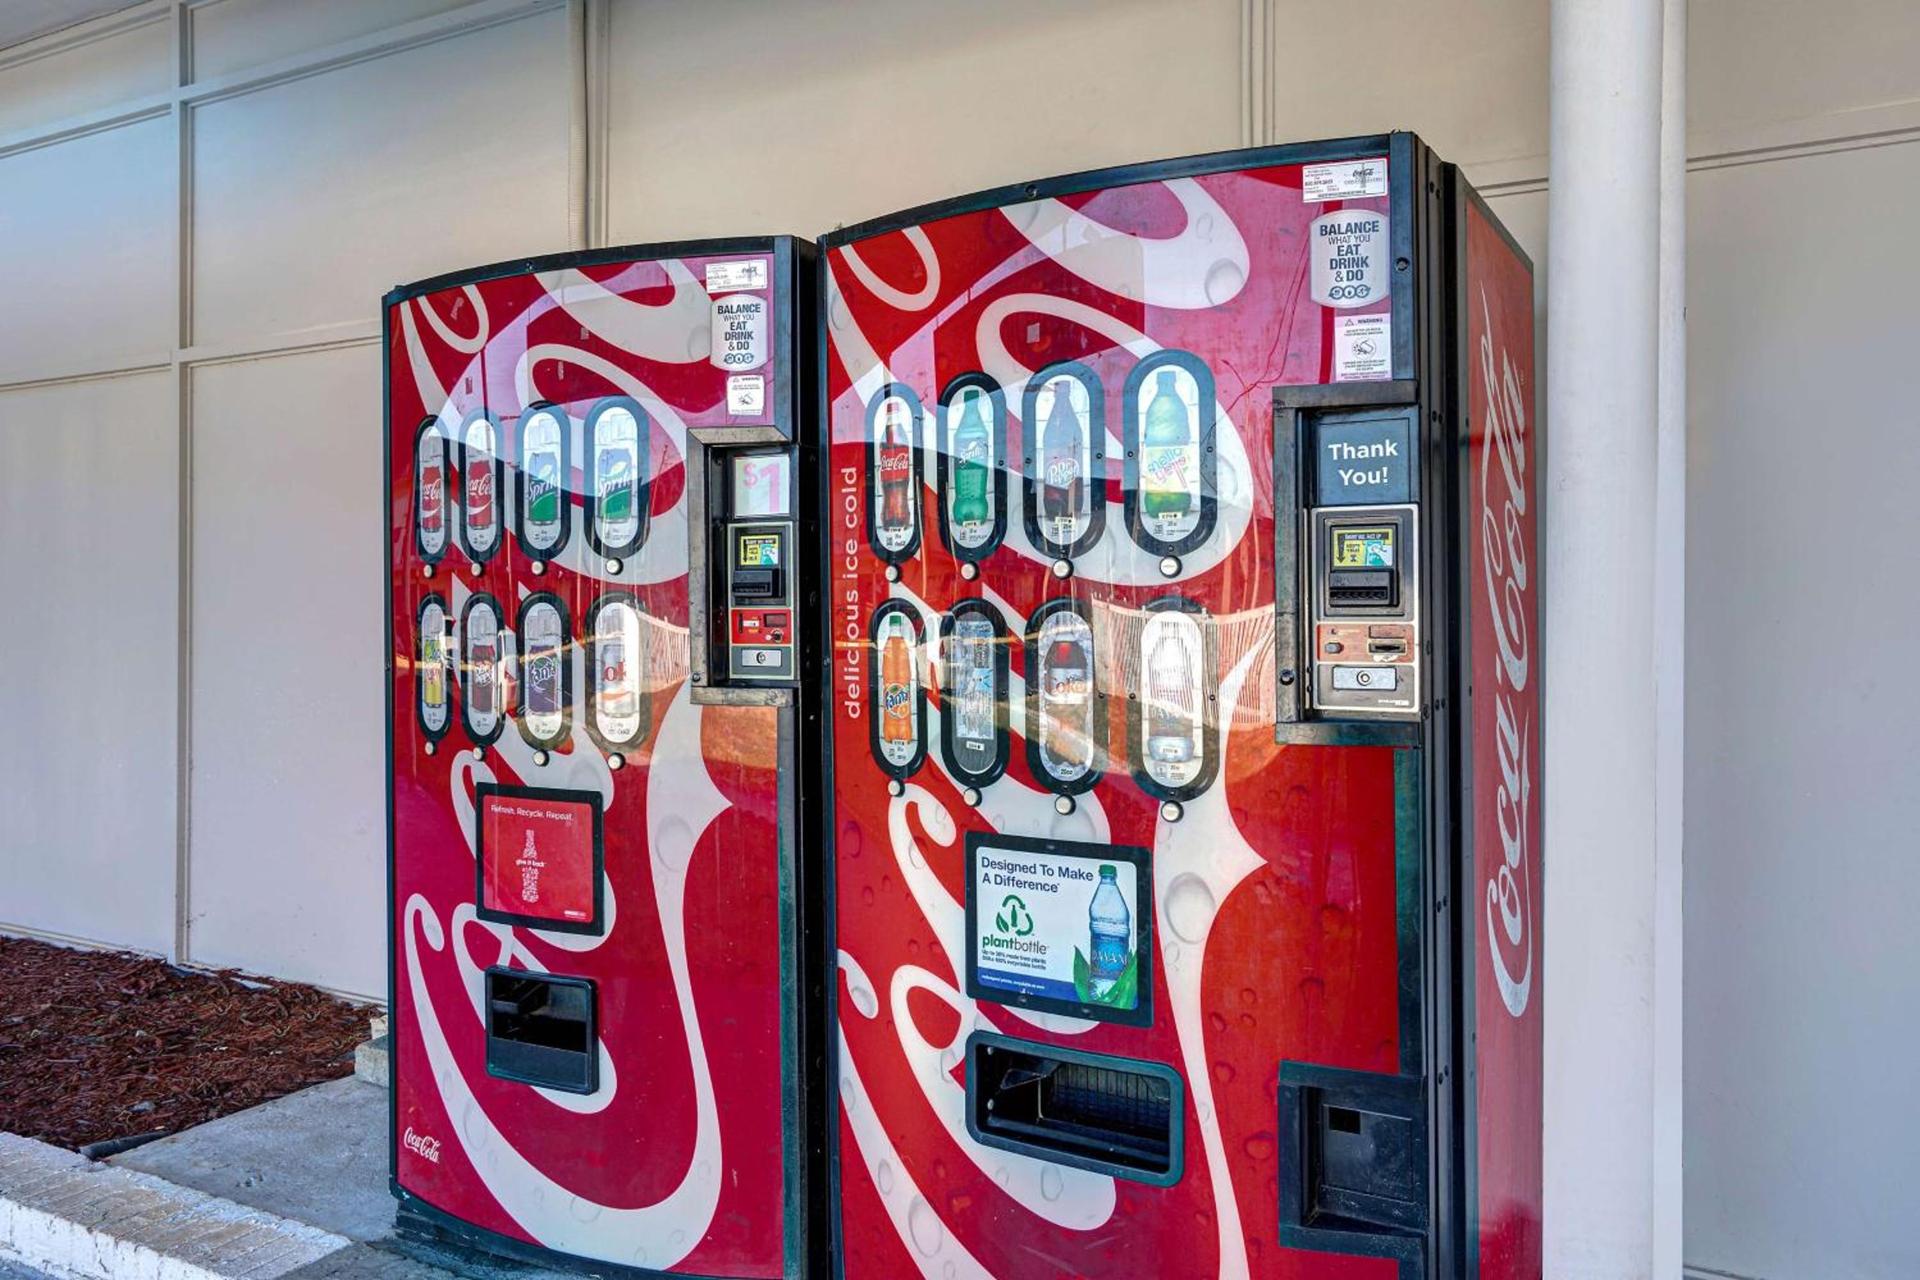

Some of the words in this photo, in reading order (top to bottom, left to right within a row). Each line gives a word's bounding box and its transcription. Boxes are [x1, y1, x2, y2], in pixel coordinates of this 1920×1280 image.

[1319, 220, 1379, 237] BALANCE
[1328, 235, 1351, 246] WHAT
[1353, 234, 1371, 244] YOU
[1336, 243, 1362, 257] EAT
[1329, 255, 1370, 270] DRINK
[1334, 270, 1345, 283] &
[1346, 268, 1364, 283] DO
[717, 303, 761, 315] BALANCE
[723, 314, 741, 322] WHAT
[742, 313, 755, 321] YOU
[729, 321, 748, 332] EAT
[724, 331, 754, 342] DRINK
[727, 342, 736, 351] &
[736, 341, 750, 351] DO
[1328, 439, 1399, 460] Thank
[1338, 466, 1389, 486] You!
[742, 462, 782, 513] $1
[841, 466, 859, 529] cold
[842, 538, 859, 579] ice
[843, 589, 861, 720] delicious
[1481, 280, 1533, 1017] Coca-Cola
[981, 856, 1037, 875] Designed
[1039, 863, 1055, 877] To
[1058, 866, 1094, 882] Make
[982, 872, 992, 885] A
[982, 933, 1047, 955] plantbottle
